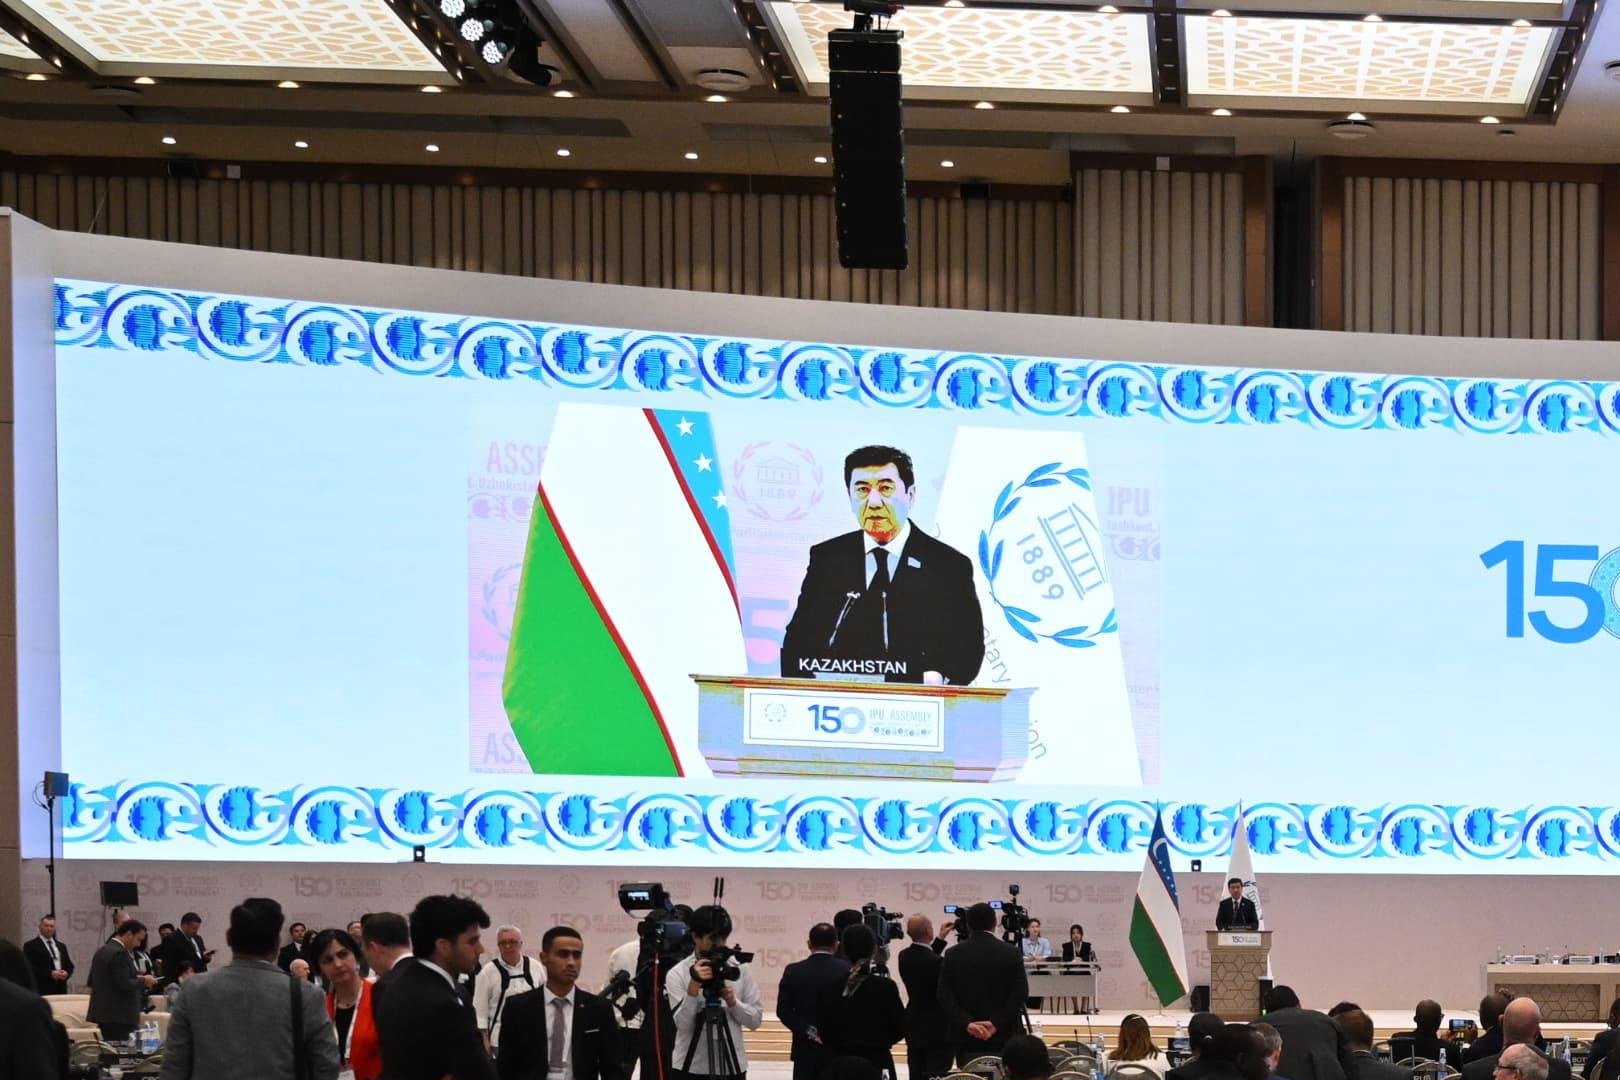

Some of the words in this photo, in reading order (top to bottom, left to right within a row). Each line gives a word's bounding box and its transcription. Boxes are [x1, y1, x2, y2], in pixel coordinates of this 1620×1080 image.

[1107, 486, 1150, 517] IPU
[1016, 533, 1065, 600] 1889
[799, 658, 907, 674] KAZAKHSTAN
[807, 703, 866, 734] 150
[290, 875, 333, 897] 150
[451, 878, 492, 898] 150
[756, 880, 796, 900] 150
[902, 882, 941, 902] 150
[551, 913, 591, 934] 150
